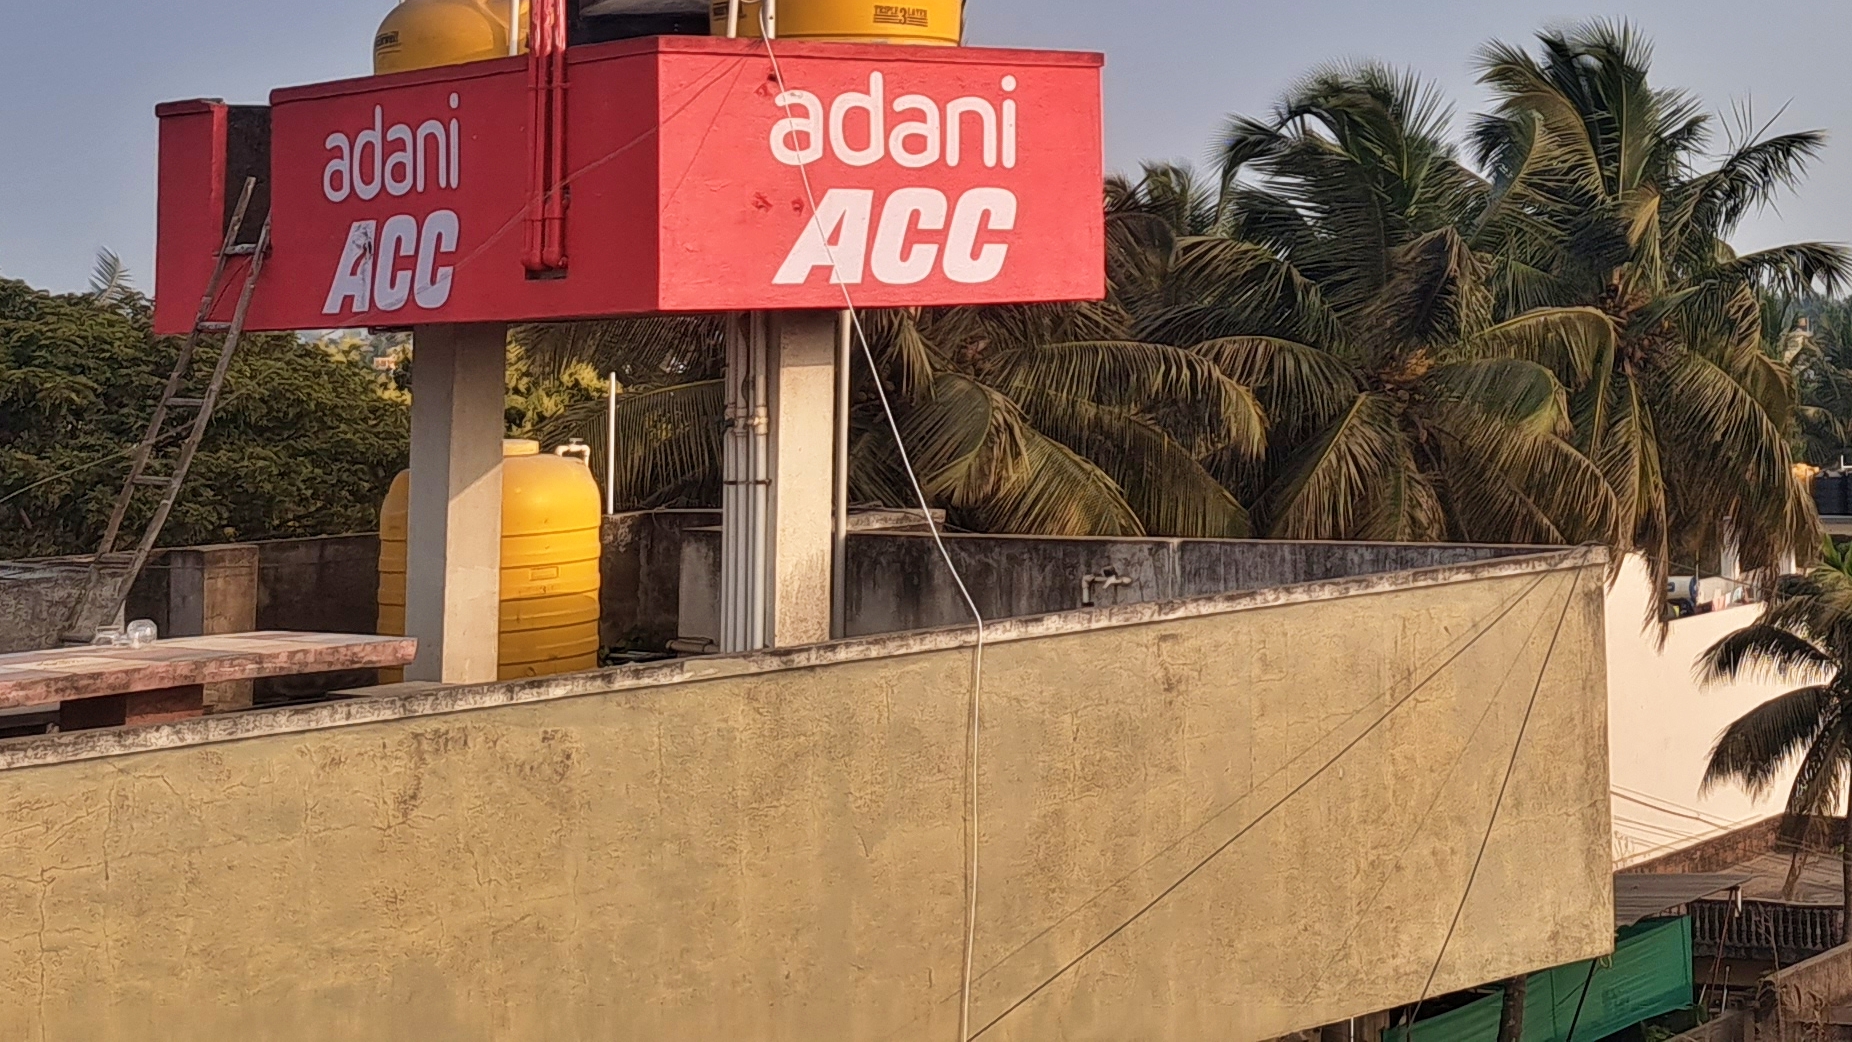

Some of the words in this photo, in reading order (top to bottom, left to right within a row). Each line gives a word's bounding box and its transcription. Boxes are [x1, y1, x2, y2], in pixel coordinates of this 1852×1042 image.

[899, 7, 907, 25] 3
[323, 92, 459, 202] adani
[769, 70, 1017, 170] adani
[322, 209, 459, 314] ACC
[771, 187, 1018, 285] ACC
